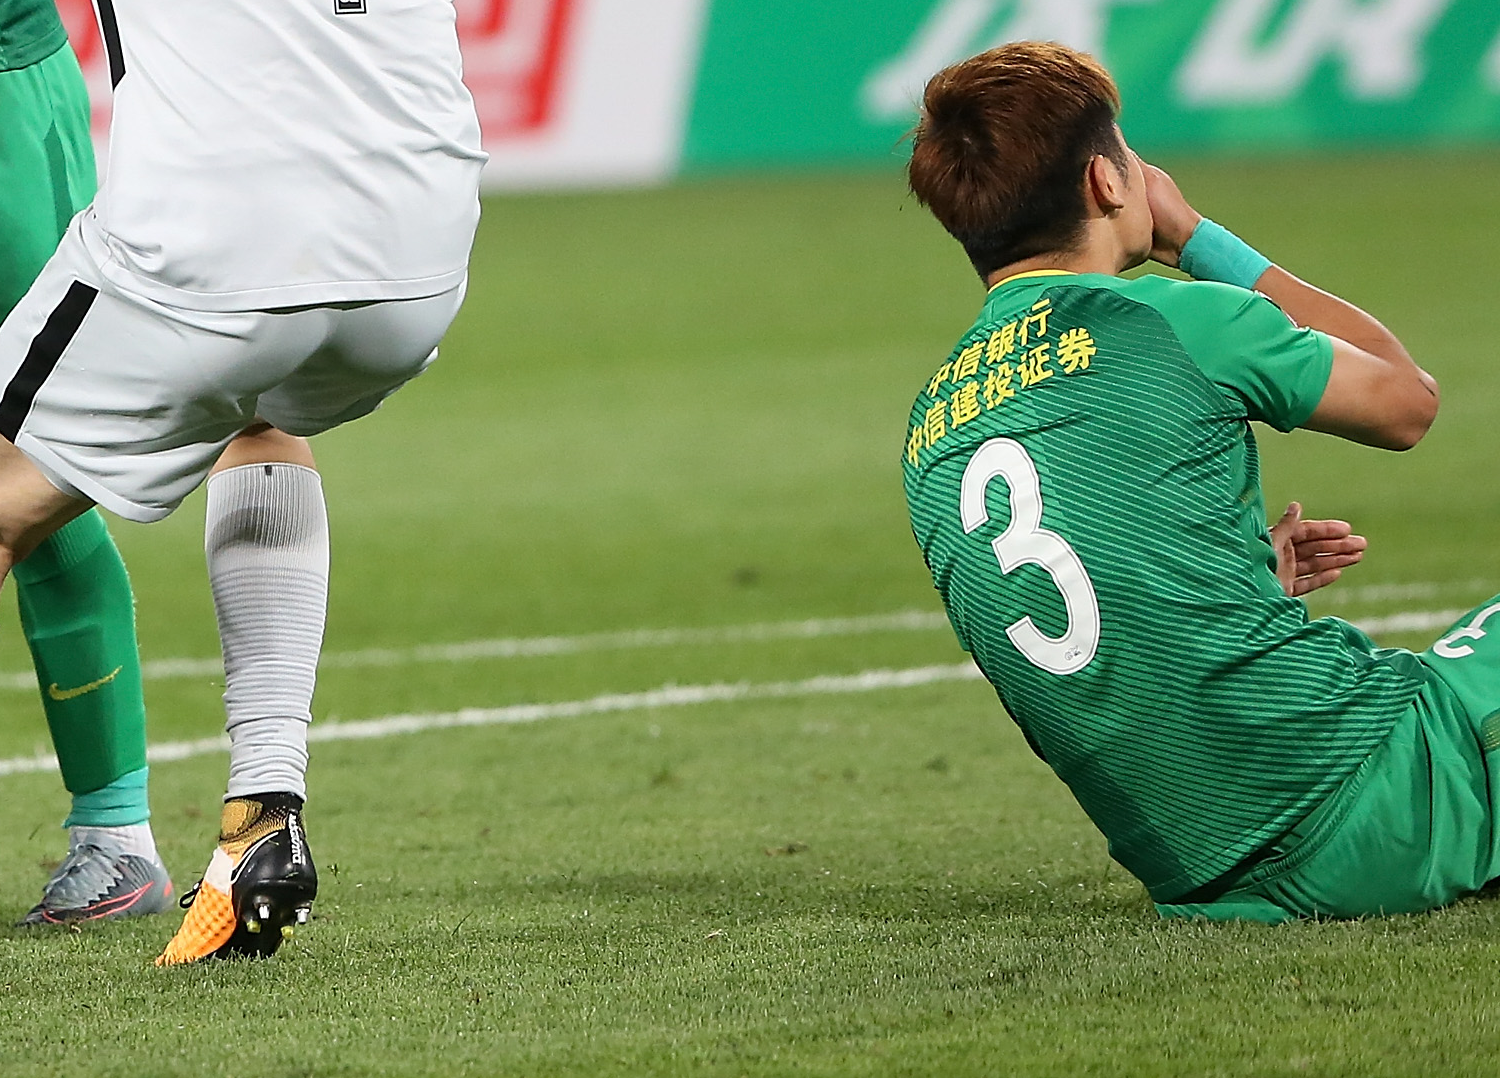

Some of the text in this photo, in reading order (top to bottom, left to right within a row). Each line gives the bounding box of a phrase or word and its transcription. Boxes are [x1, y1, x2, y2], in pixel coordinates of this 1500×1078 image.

[907, 328, 1096, 468] 中信建投证券
[927, 299, 1052, 398] 中信银行
[959, 437, 1100, 675] 3
